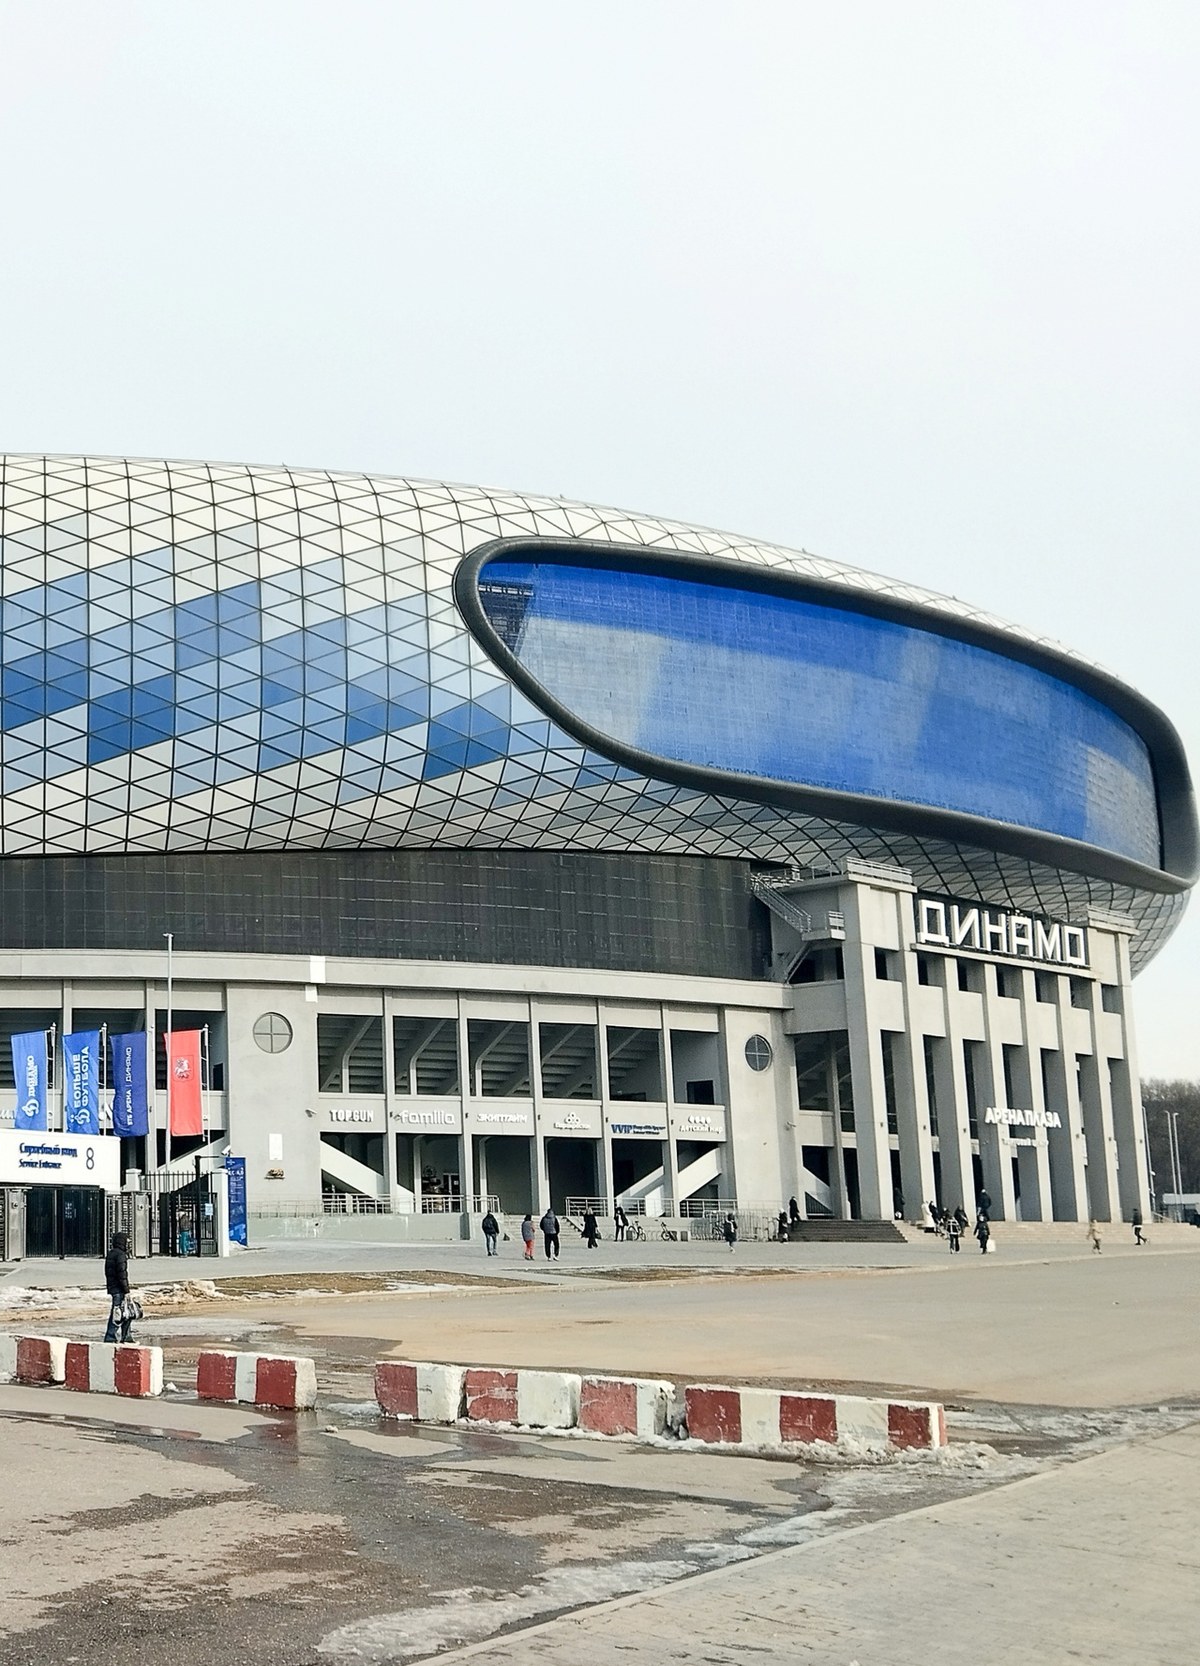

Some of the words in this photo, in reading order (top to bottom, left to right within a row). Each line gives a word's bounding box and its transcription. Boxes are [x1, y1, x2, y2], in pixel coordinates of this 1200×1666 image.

[917, 899, 1086, 966] ДИНАМО
[72, 1053, 81, 1108] БОЛЬШЕ
[81, 1046, 90, 1107] ФУТБОЛА
[125, 1047, 133, 1083] ДИНАМО
[125, 1089, 133, 1114] АРЕНА
[400, 1109, 455, 1125] familia
[86, 1147, 95, 1170] 8
